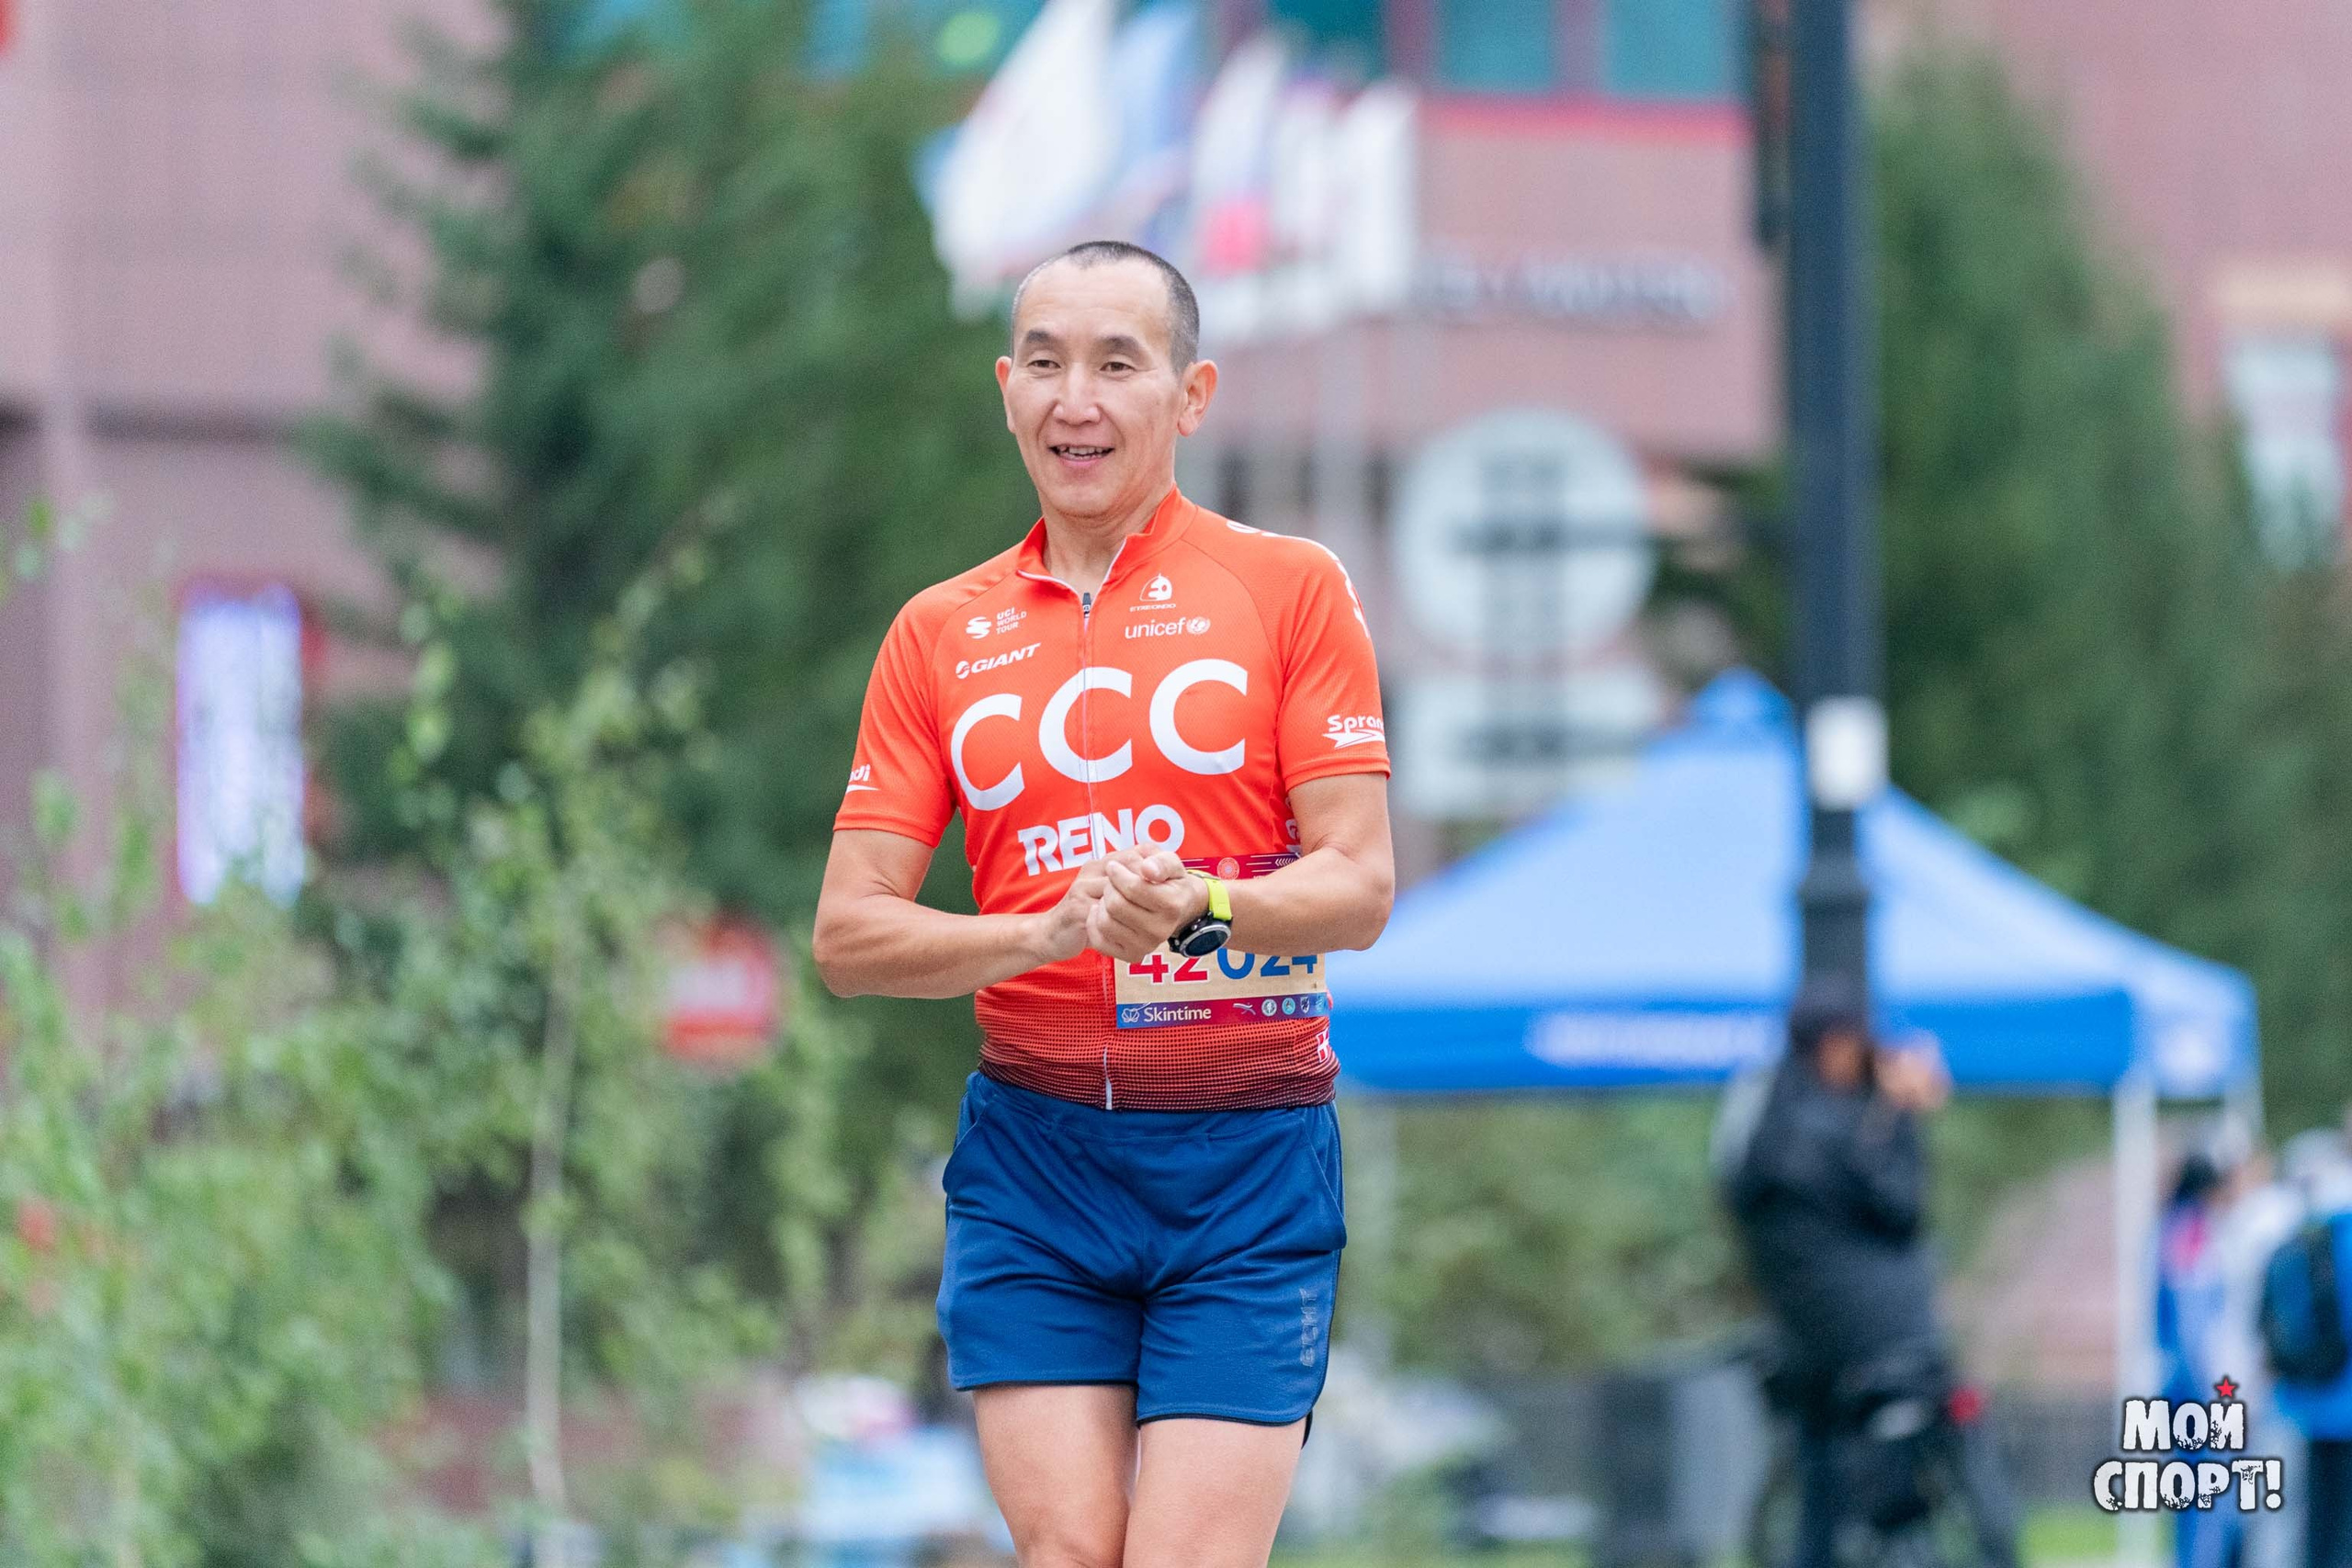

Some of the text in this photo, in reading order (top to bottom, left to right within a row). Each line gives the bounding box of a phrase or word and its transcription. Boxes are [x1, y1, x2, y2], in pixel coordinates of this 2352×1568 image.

[996, 606, 1015, 620] UCI
[997, 611, 1027, 626] WORLD
[996, 621, 1019, 635] TOUR
[1125, 616, 1186, 639] unicef
[971, 643, 1041, 674] GIANT
[951, 659, 1249, 811] CCC
[1018, 805, 1185, 876] RENO
[1143, 1006, 1212, 1023] Skintime
